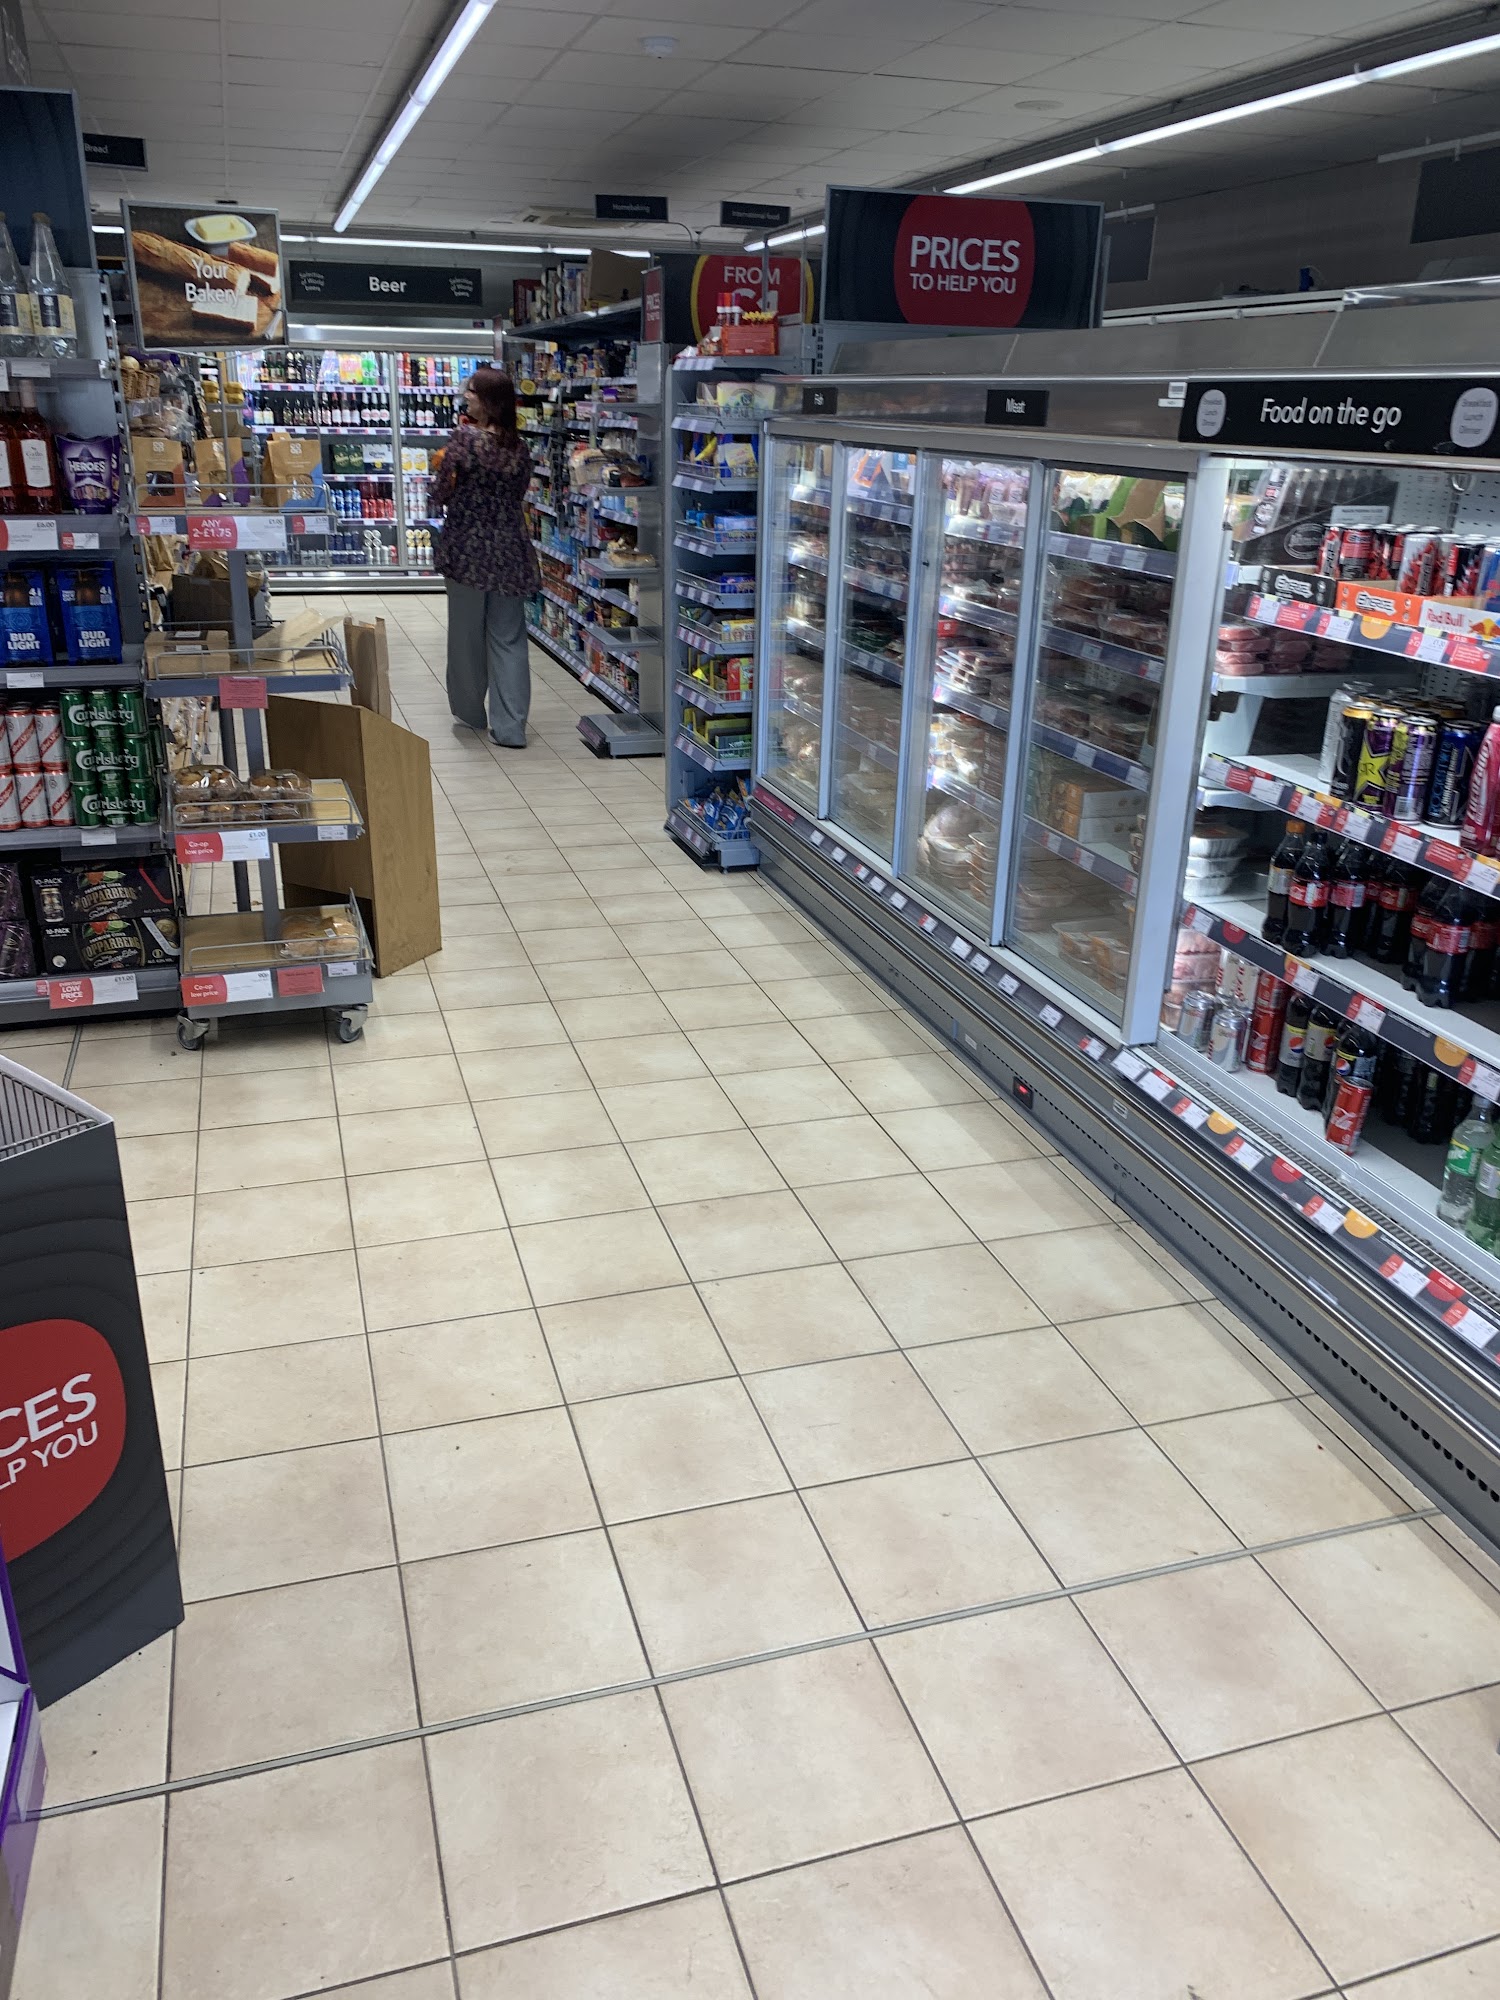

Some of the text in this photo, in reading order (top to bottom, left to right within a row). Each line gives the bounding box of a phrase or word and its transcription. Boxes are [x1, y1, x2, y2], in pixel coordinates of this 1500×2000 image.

[910, 235, 1021, 273] PRICES
[191, 259, 230, 280] Your
[723, 265, 781, 285] FROM
[368, 276, 408, 293] Beer
[910, 273, 1017, 295] TO HELP YOU
[184, 282, 241, 304] Bakery
[1260, 397, 1403, 434] Food on the go
[69, 460, 106, 474] HEROES
[201, 519, 222, 528] ANY
[9, 632, 36, 642] BUD
[78, 638, 111, 648] LIGHT
[81, 631, 107, 640] BUD
[7, 641, 41, 650] LIGHT
[68, 704, 135, 727] Carlsberg
[75, 749, 140, 771] Carlsberg
[81, 793, 146, 816] Carlsberg
[188, 841, 210, 849] Co-op
[198, 847, 214, 856] price
[60, 992, 83, 1000] PRICE
[203, 990, 219, 998] price
[32, 1420, 98, 1468] YOU
